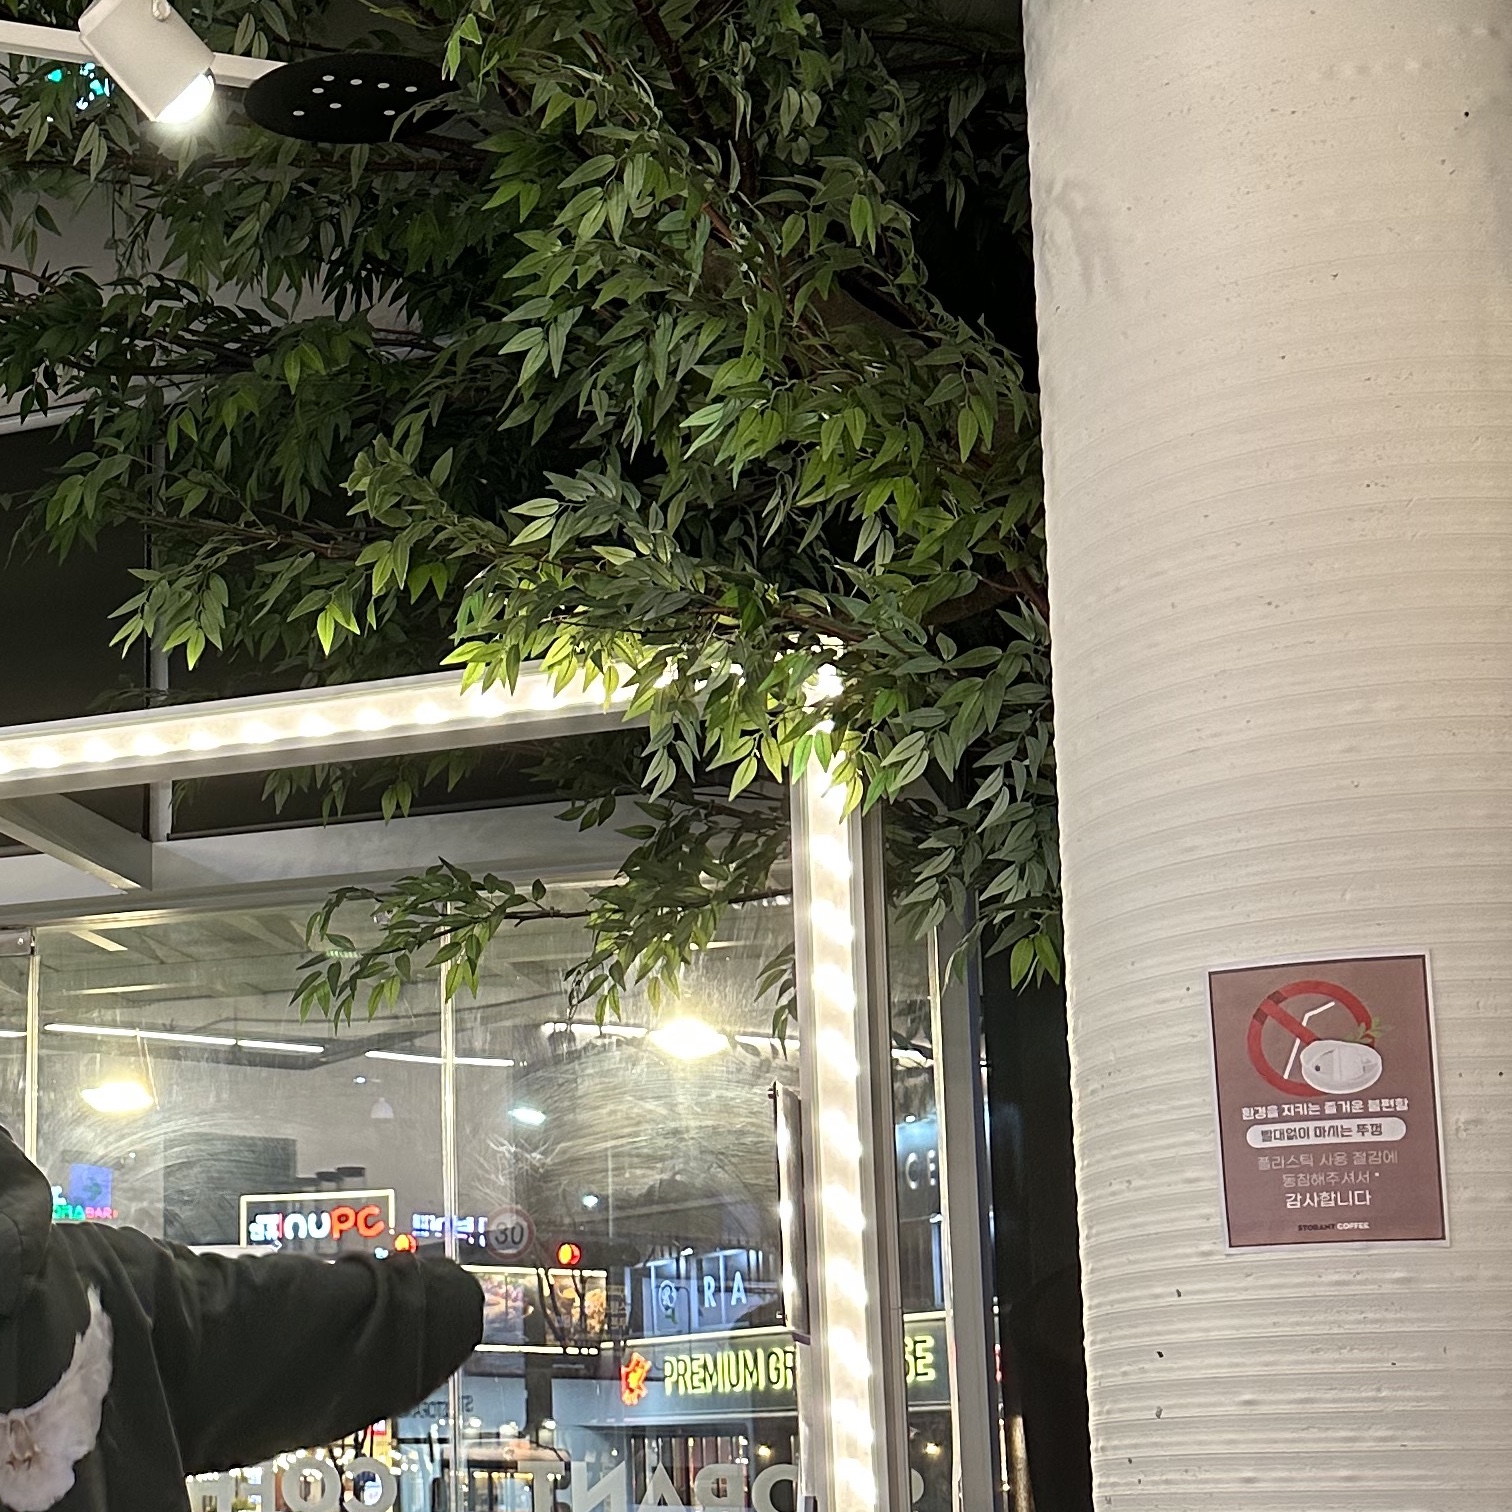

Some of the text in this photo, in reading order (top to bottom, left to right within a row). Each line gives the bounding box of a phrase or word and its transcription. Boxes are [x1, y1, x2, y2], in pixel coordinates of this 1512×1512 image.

[1241, 1097, 1409, 1121] 환경을 지키는 즐거운 불편함
[1261, 1122, 1384, 1143] 빨대없이 마시는 뚜껑
[1257, 1150, 1399, 1171] 플라스틱 사용 절감에
[1285, 1189, 1372, 1209] 감사합니다
[494, 1221, 524, 1246] 30
[1336, 1221, 1370, 1231] COFFEE
[664, 1348, 765, 1396] PREMIUM
